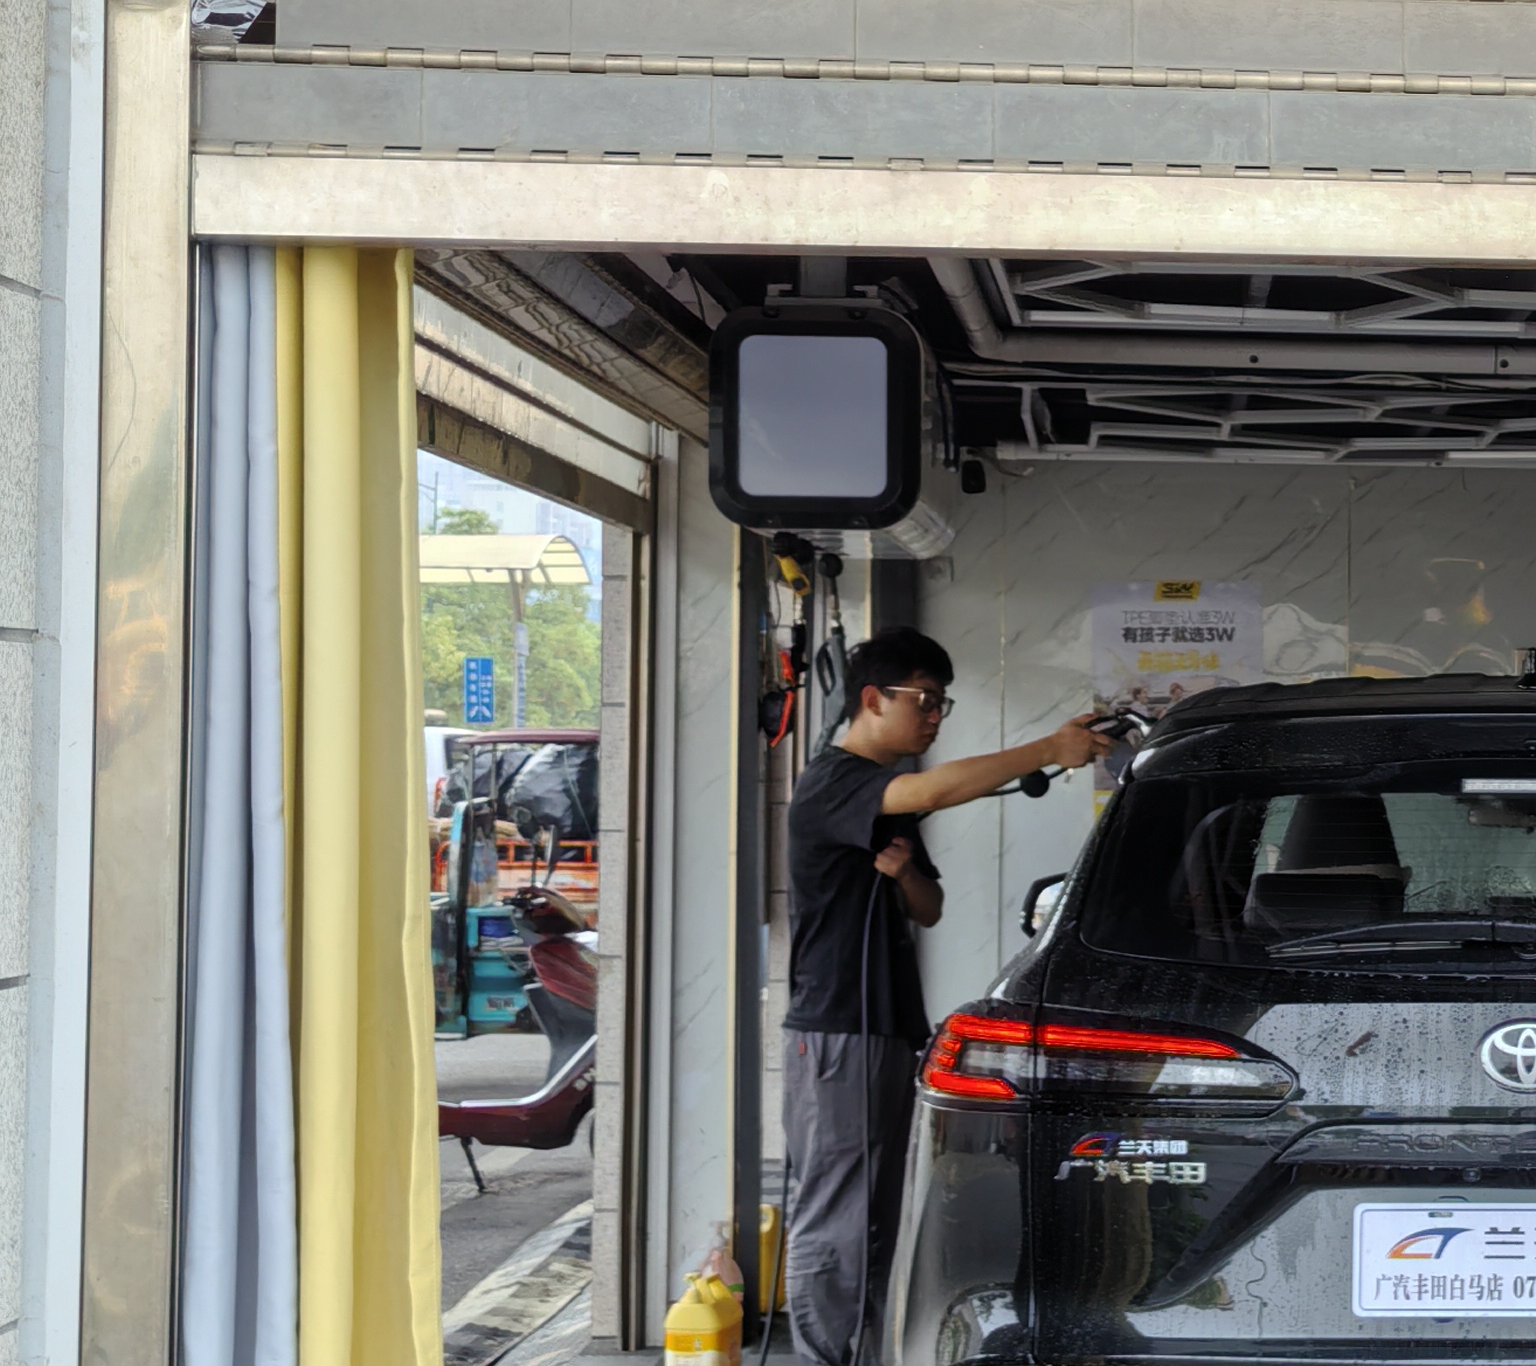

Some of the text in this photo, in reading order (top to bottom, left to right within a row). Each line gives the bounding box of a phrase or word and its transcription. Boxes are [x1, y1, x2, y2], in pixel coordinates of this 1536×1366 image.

[1122, 626, 1235, 643] 有孩子就选3W
[1117, 1140, 1188, 1156] 兰天集团
[1053, 1159, 1207, 1184] 广汽丰田
[1374, 1273, 1503, 1302] 广汽丰田白马店
